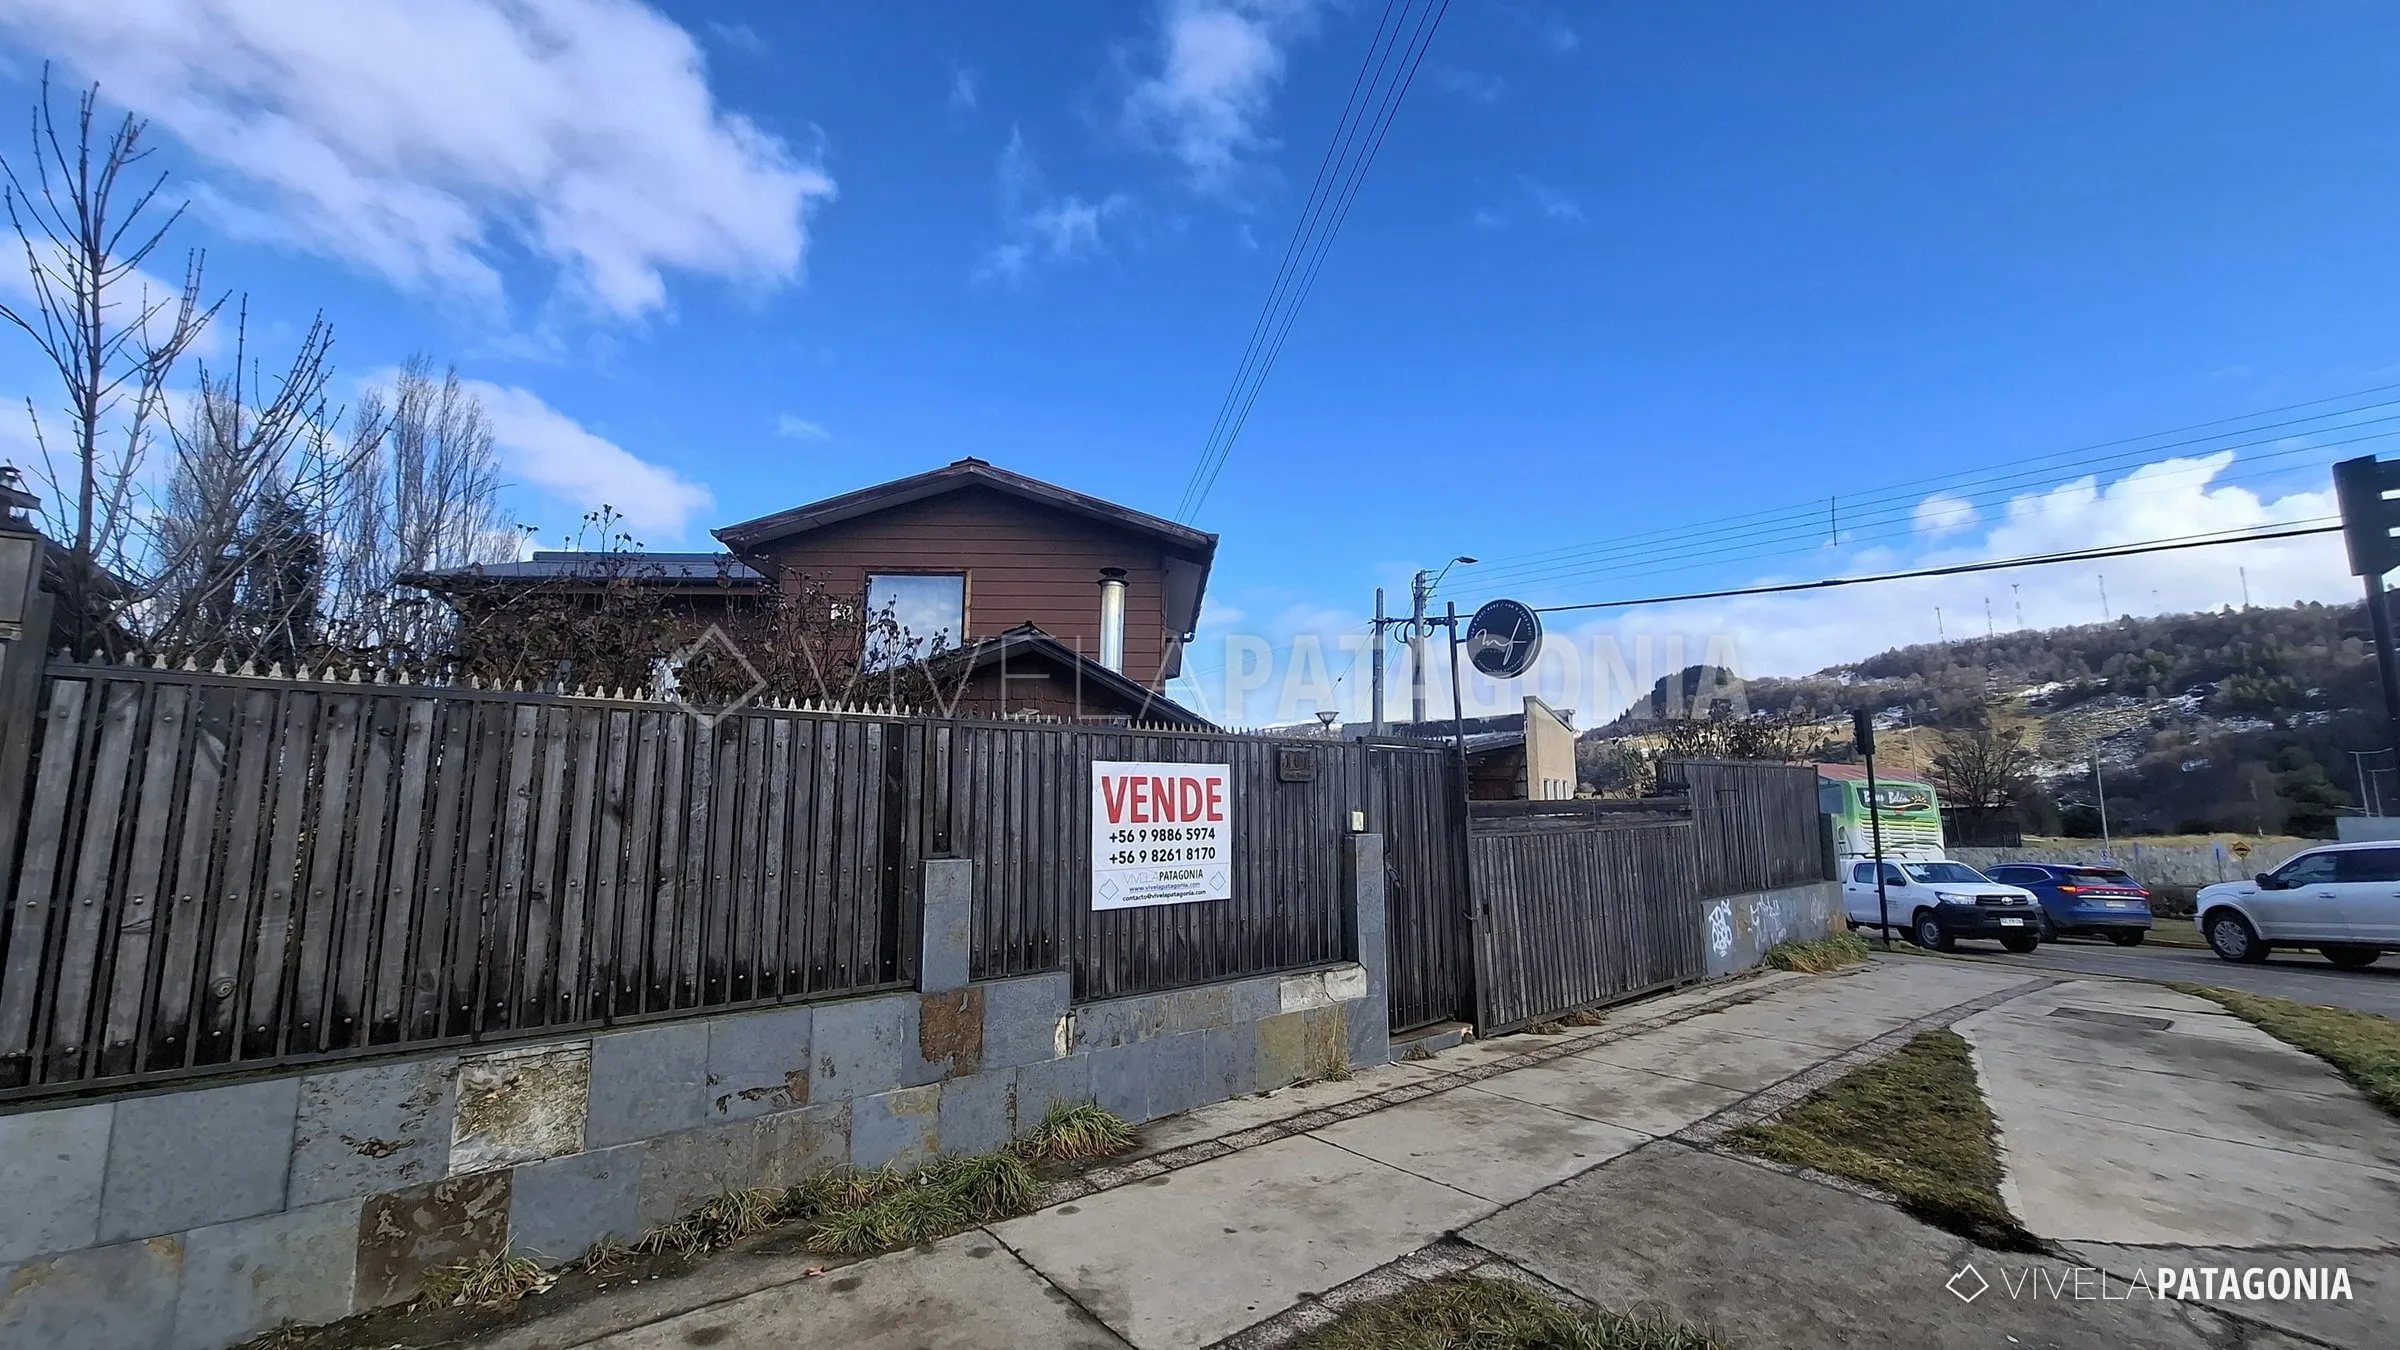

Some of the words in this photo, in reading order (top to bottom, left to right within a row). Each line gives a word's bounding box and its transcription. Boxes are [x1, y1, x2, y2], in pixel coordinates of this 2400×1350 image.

[1101, 775, 1224, 824] VENDE
[1109, 829, 1135, 844] +56
[1138, 828, 1147, 842] 9
[1151, 828, 1182, 843] 9886
[1186, 827, 1216, 841] 5974
[1109, 850, 1135, 865] +56
[1138, 849, 1147, 863] 9
[1151, 848, 1181, 863] 8261
[1186, 846, 1216, 861] 8170
[1129, 881, 1200, 892] www.vivelapatagonia.com
[1122, 889, 1207, 902] contacto@vivelapatagonia.com
